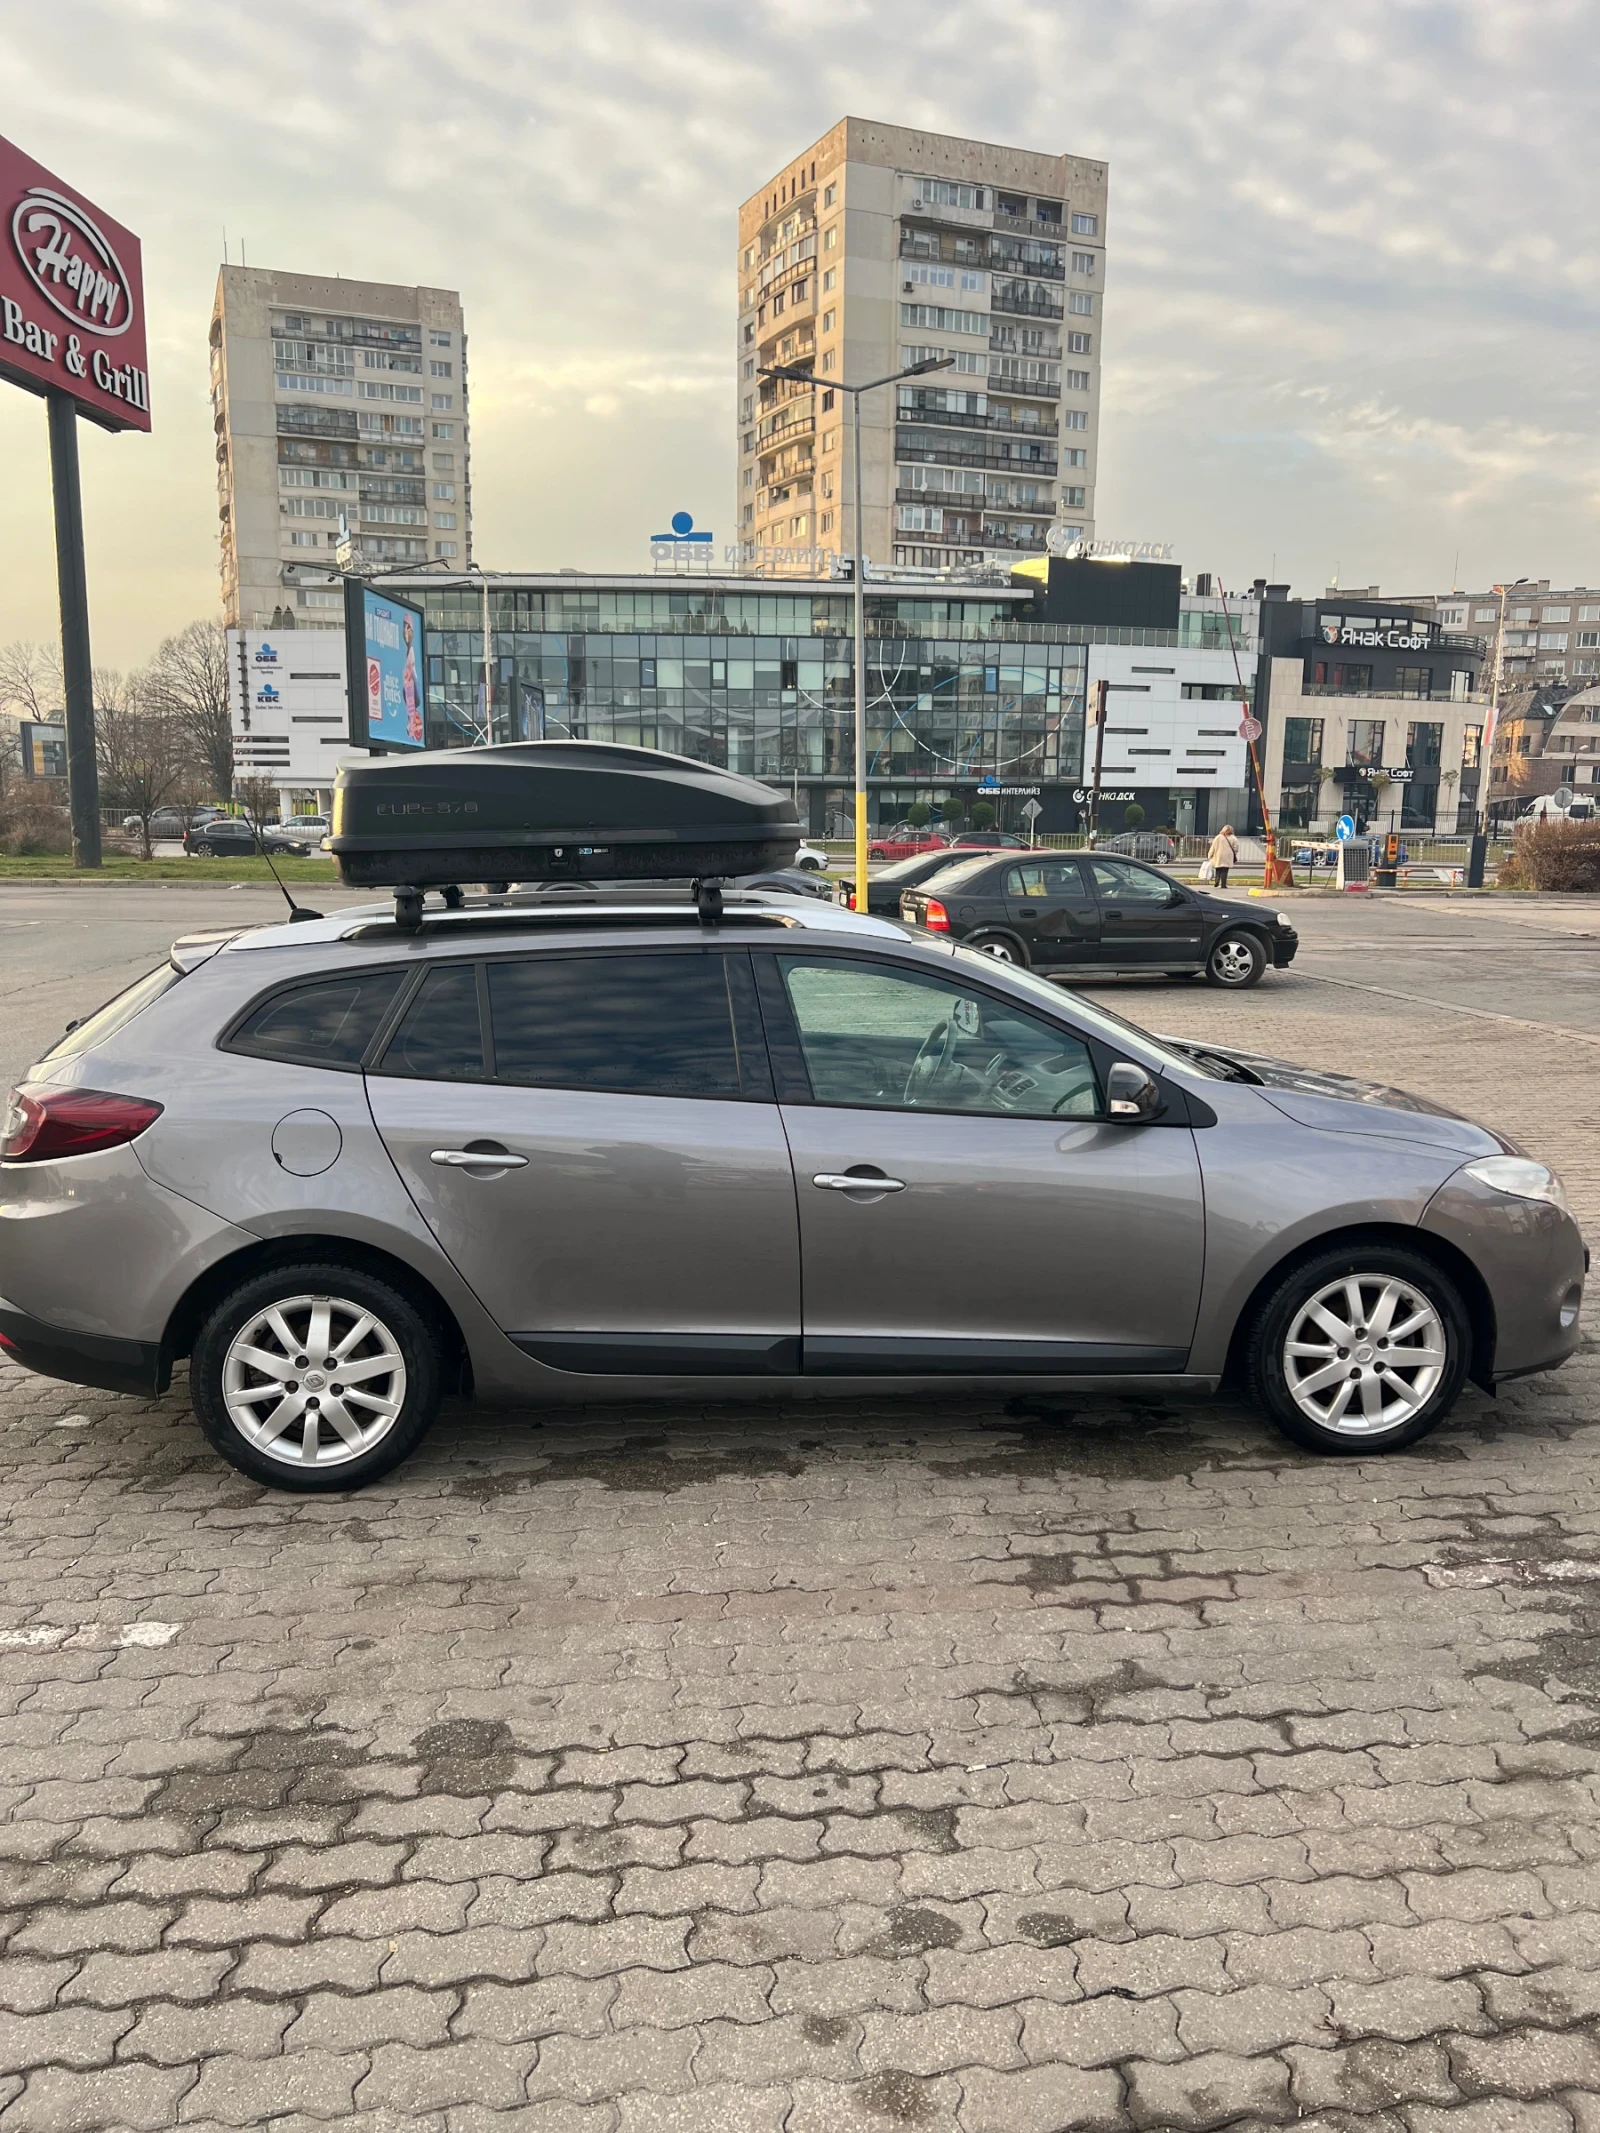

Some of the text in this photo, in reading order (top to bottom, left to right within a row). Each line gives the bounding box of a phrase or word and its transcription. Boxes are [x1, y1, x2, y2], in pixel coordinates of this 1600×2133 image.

[28, 213, 120, 325] Happy
[1, 295, 149, 412] Bar & Grill
[650, 543, 714, 562] ОББ
[1341, 627, 1431, 650] Янак Софт
[1245, 721, 1256, 739] STOP
[1391, 768, 1414, 778] Софт
[977, 787, 1041, 796] ОББ ИНТЕРЛИЙЗ
